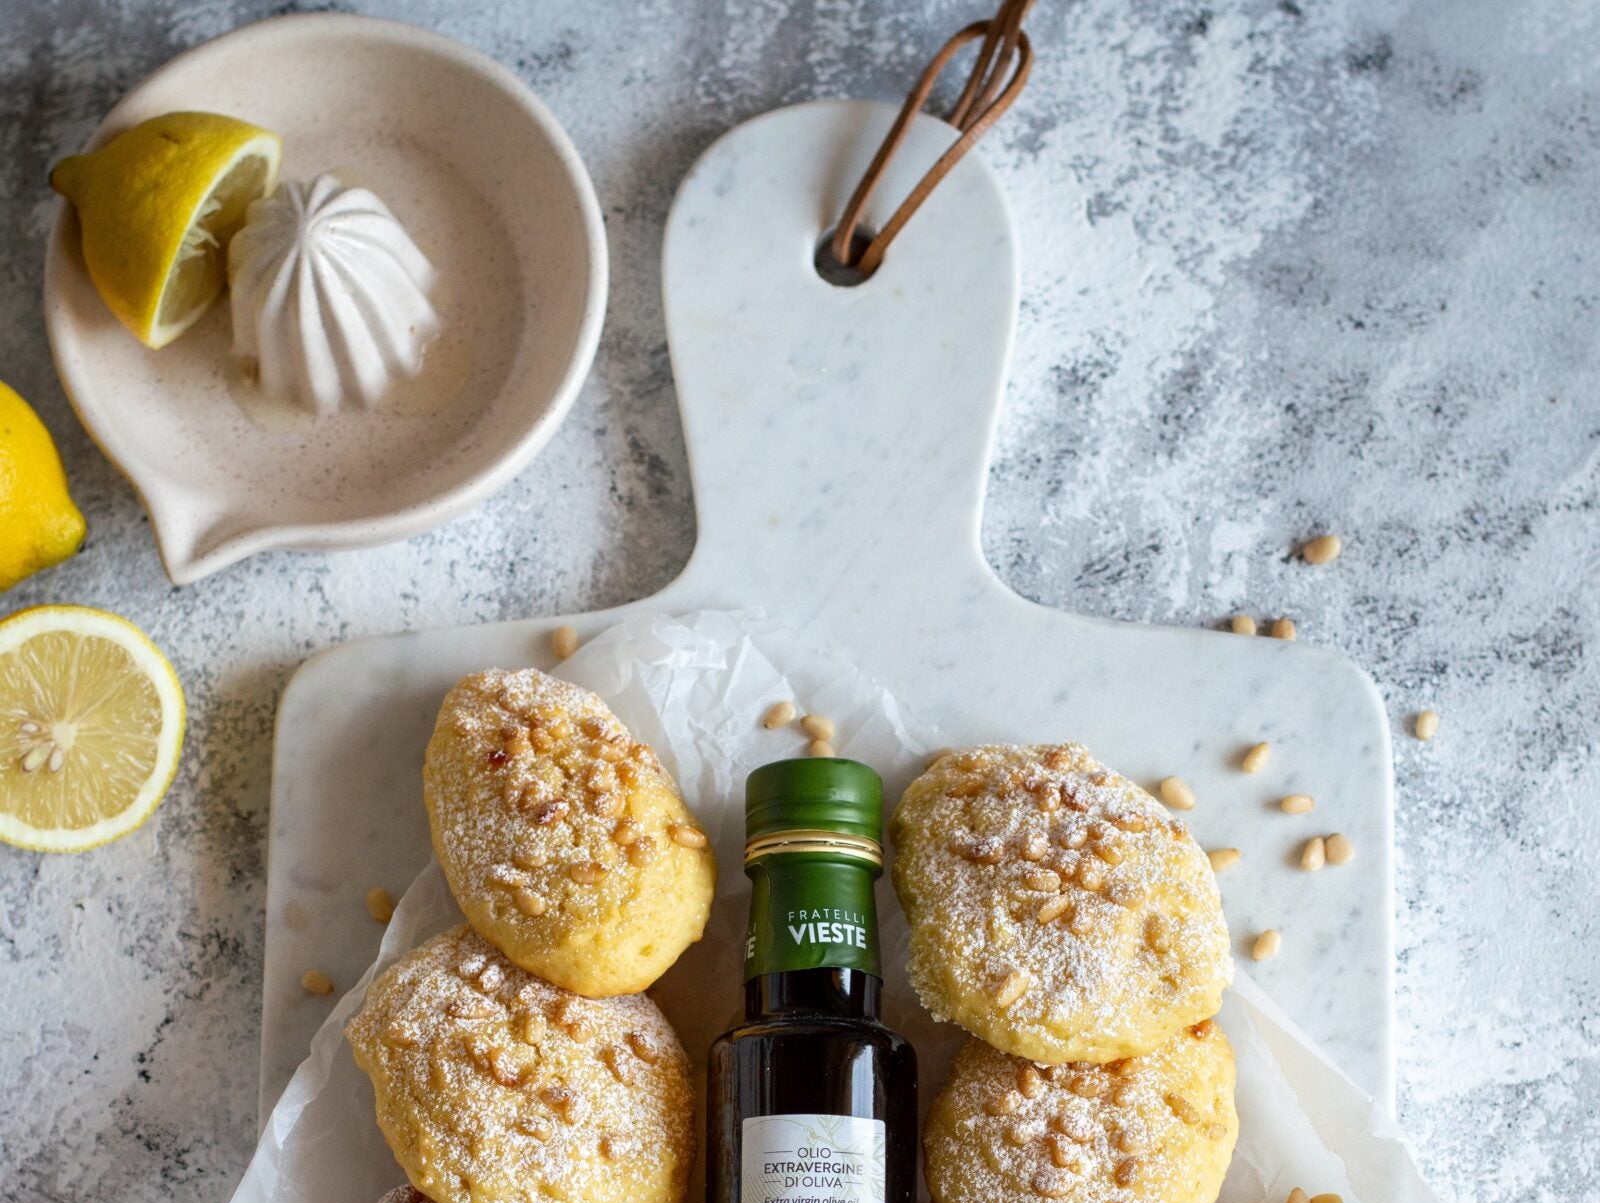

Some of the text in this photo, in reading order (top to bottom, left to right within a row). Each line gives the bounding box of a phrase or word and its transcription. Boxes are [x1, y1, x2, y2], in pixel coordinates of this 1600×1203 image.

[788, 909, 865, 924] FRATELLI
[787, 922, 867, 949] VIESTE
[797, 1147, 831, 1159] OLIO
[764, 1162, 863, 1176] EXTRAVERGINE
[785, 1176, 843, 1188] DI OLIVA
